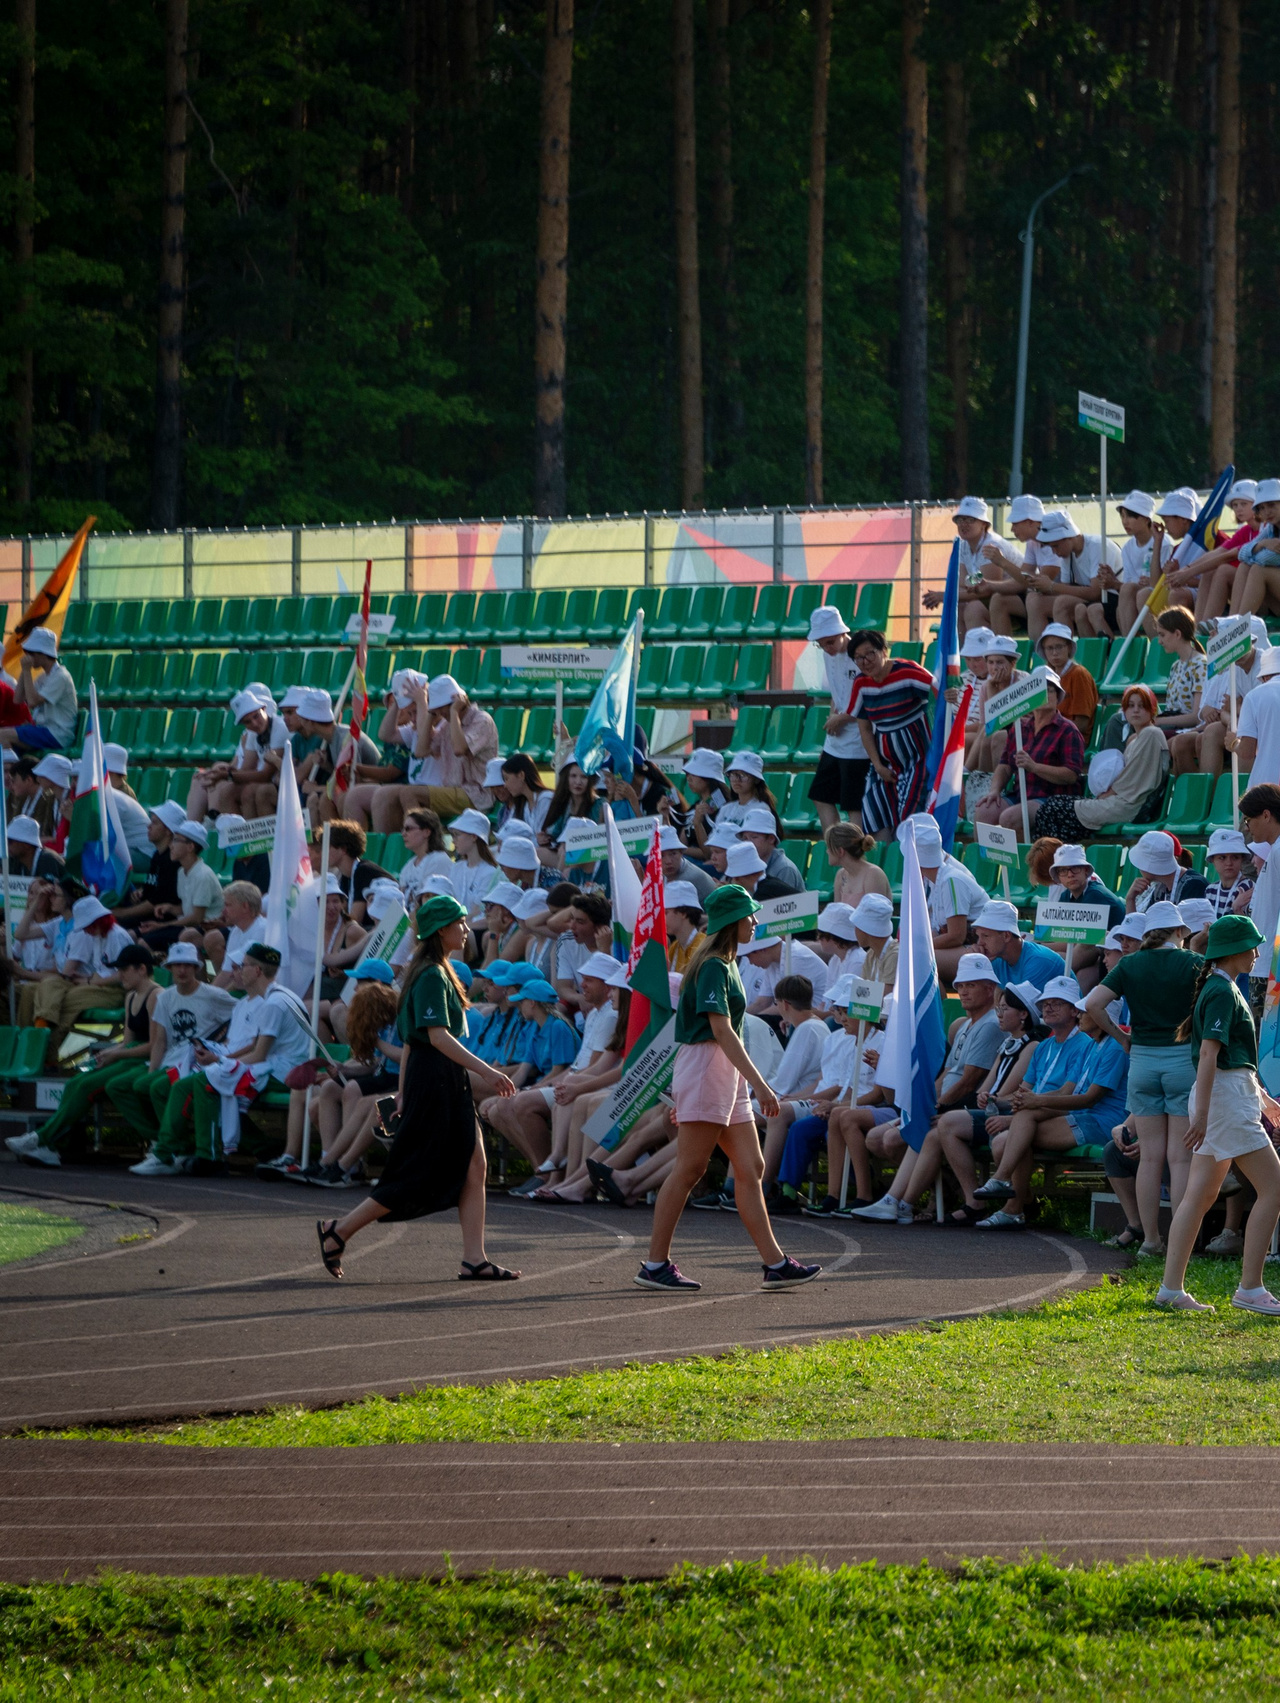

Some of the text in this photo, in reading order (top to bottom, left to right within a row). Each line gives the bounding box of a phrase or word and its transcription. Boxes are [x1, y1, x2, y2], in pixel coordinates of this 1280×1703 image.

[527, 652, 591, 664] «КИМБЕРЛИТ»
[988, 694, 1008, 714] «ОМСКИЕ
[1042, 906, 1102, 922] «АЛТАЙСКИЕ СОРОКИ»
[609, 1045, 673, 1121] РЕСПУБЛИКИ БЕЛАРУСЬ»
[614, 1049, 657, 1102] «ЮНЫЕ ГЕОЛОГИ
[617, 1085, 658, 1131] Республика
